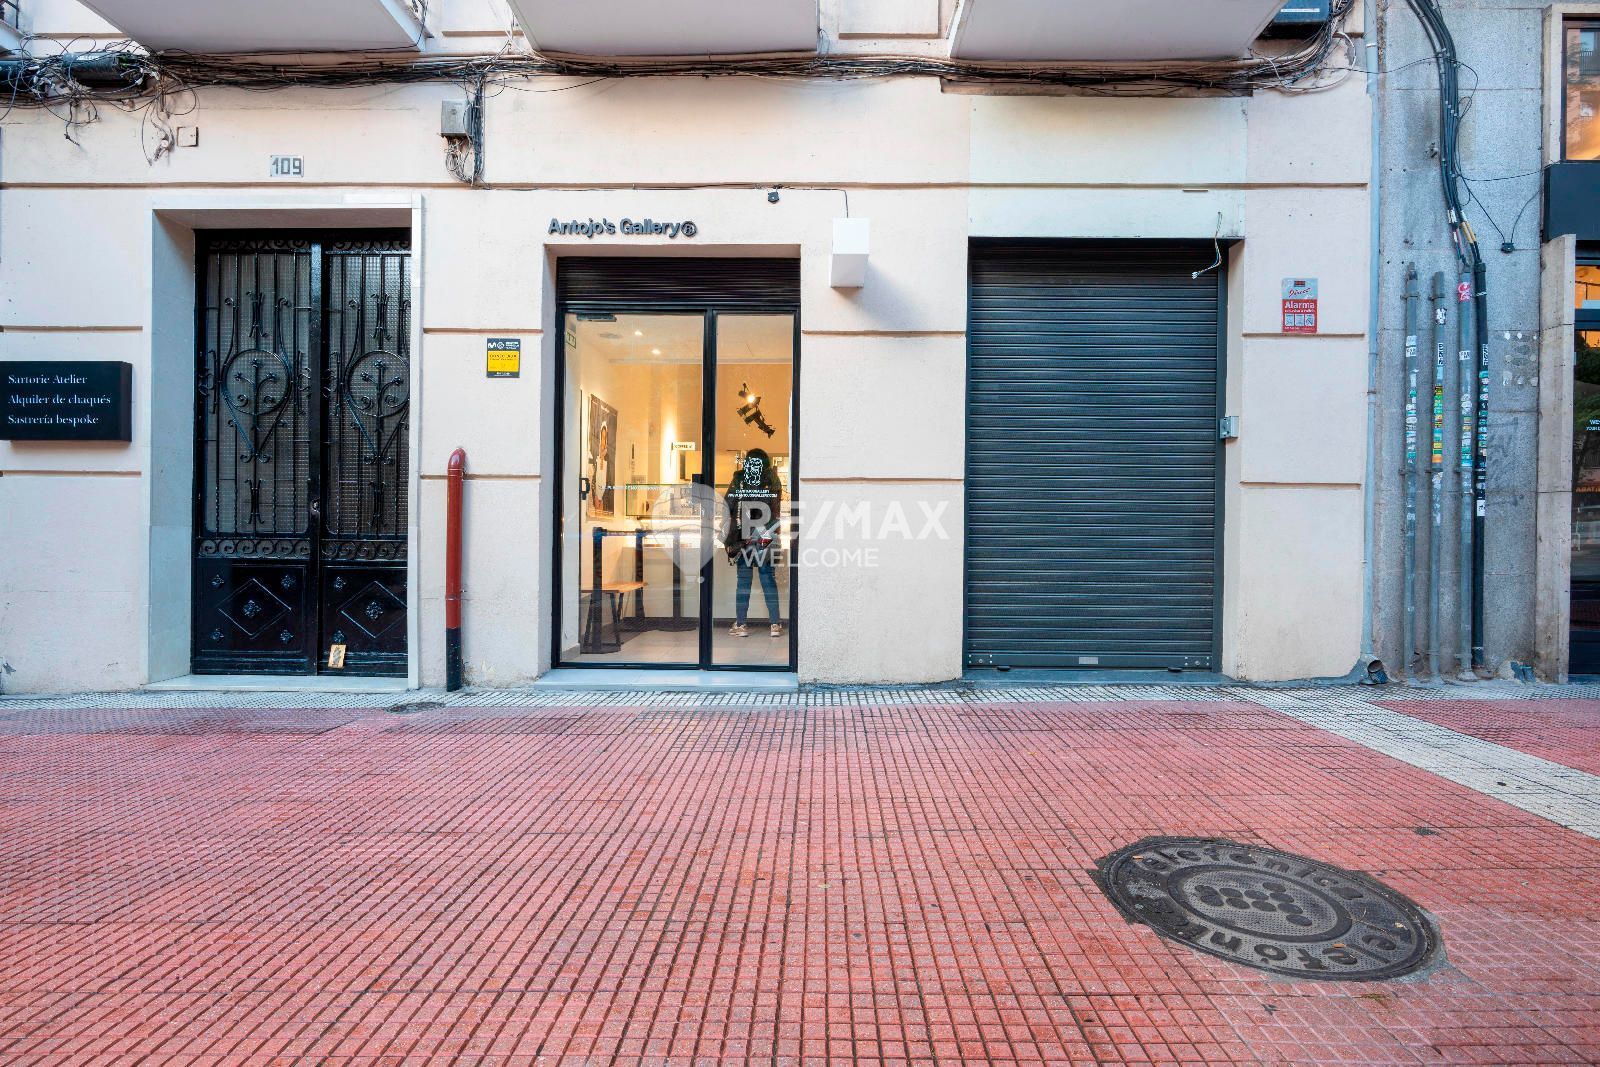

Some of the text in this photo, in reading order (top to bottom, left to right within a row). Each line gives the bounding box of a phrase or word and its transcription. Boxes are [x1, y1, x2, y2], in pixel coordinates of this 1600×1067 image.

[272, 157, 301, 175] 109
[547, 218, 616, 238] Antojo's
[1285, 301, 1314, 309] Alarma
[52, 374, 88, 384] Atelier
[8, 394, 111, 407] Alquiler de chaqués
[8, 414, 99, 427] Sastrería bespoke
